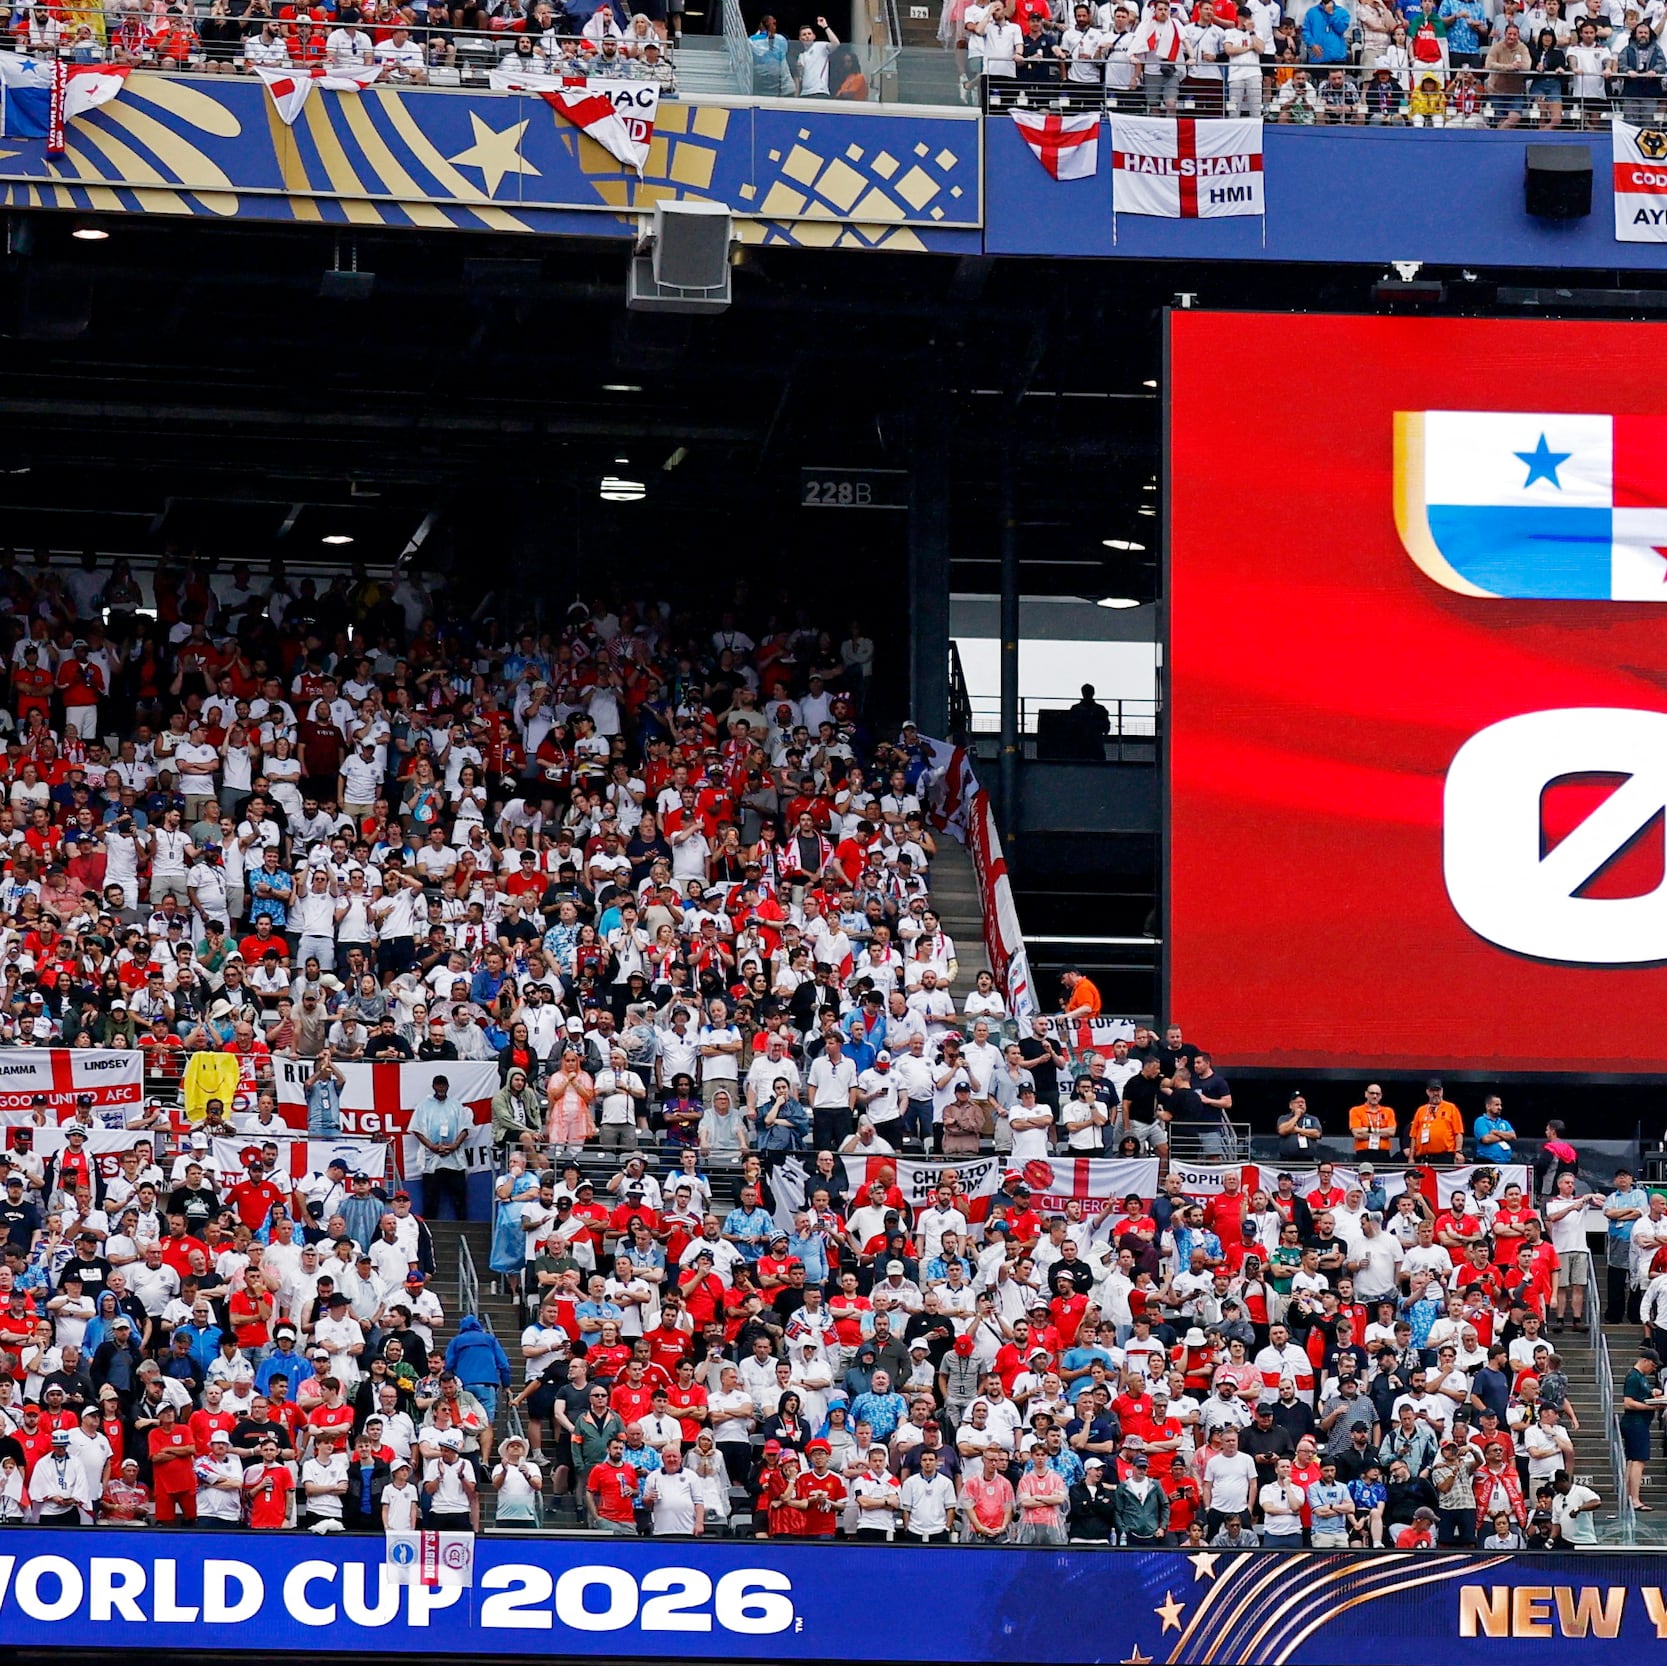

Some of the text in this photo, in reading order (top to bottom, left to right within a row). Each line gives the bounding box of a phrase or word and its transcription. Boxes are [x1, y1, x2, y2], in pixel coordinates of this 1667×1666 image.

[1124, 153, 1250, 176] HAILSHAM
[1210, 186, 1252, 204] HMI
[84, 1059, 130, 1072] LINDSEY
[105, 1087, 132, 1102] AFC
[0, 1553, 266, 1624] ORLD
[282, 1558, 466, 1628] CUP
[479, 1565, 795, 1635] 2026
[1460, 1586, 1622, 1640] NEW
